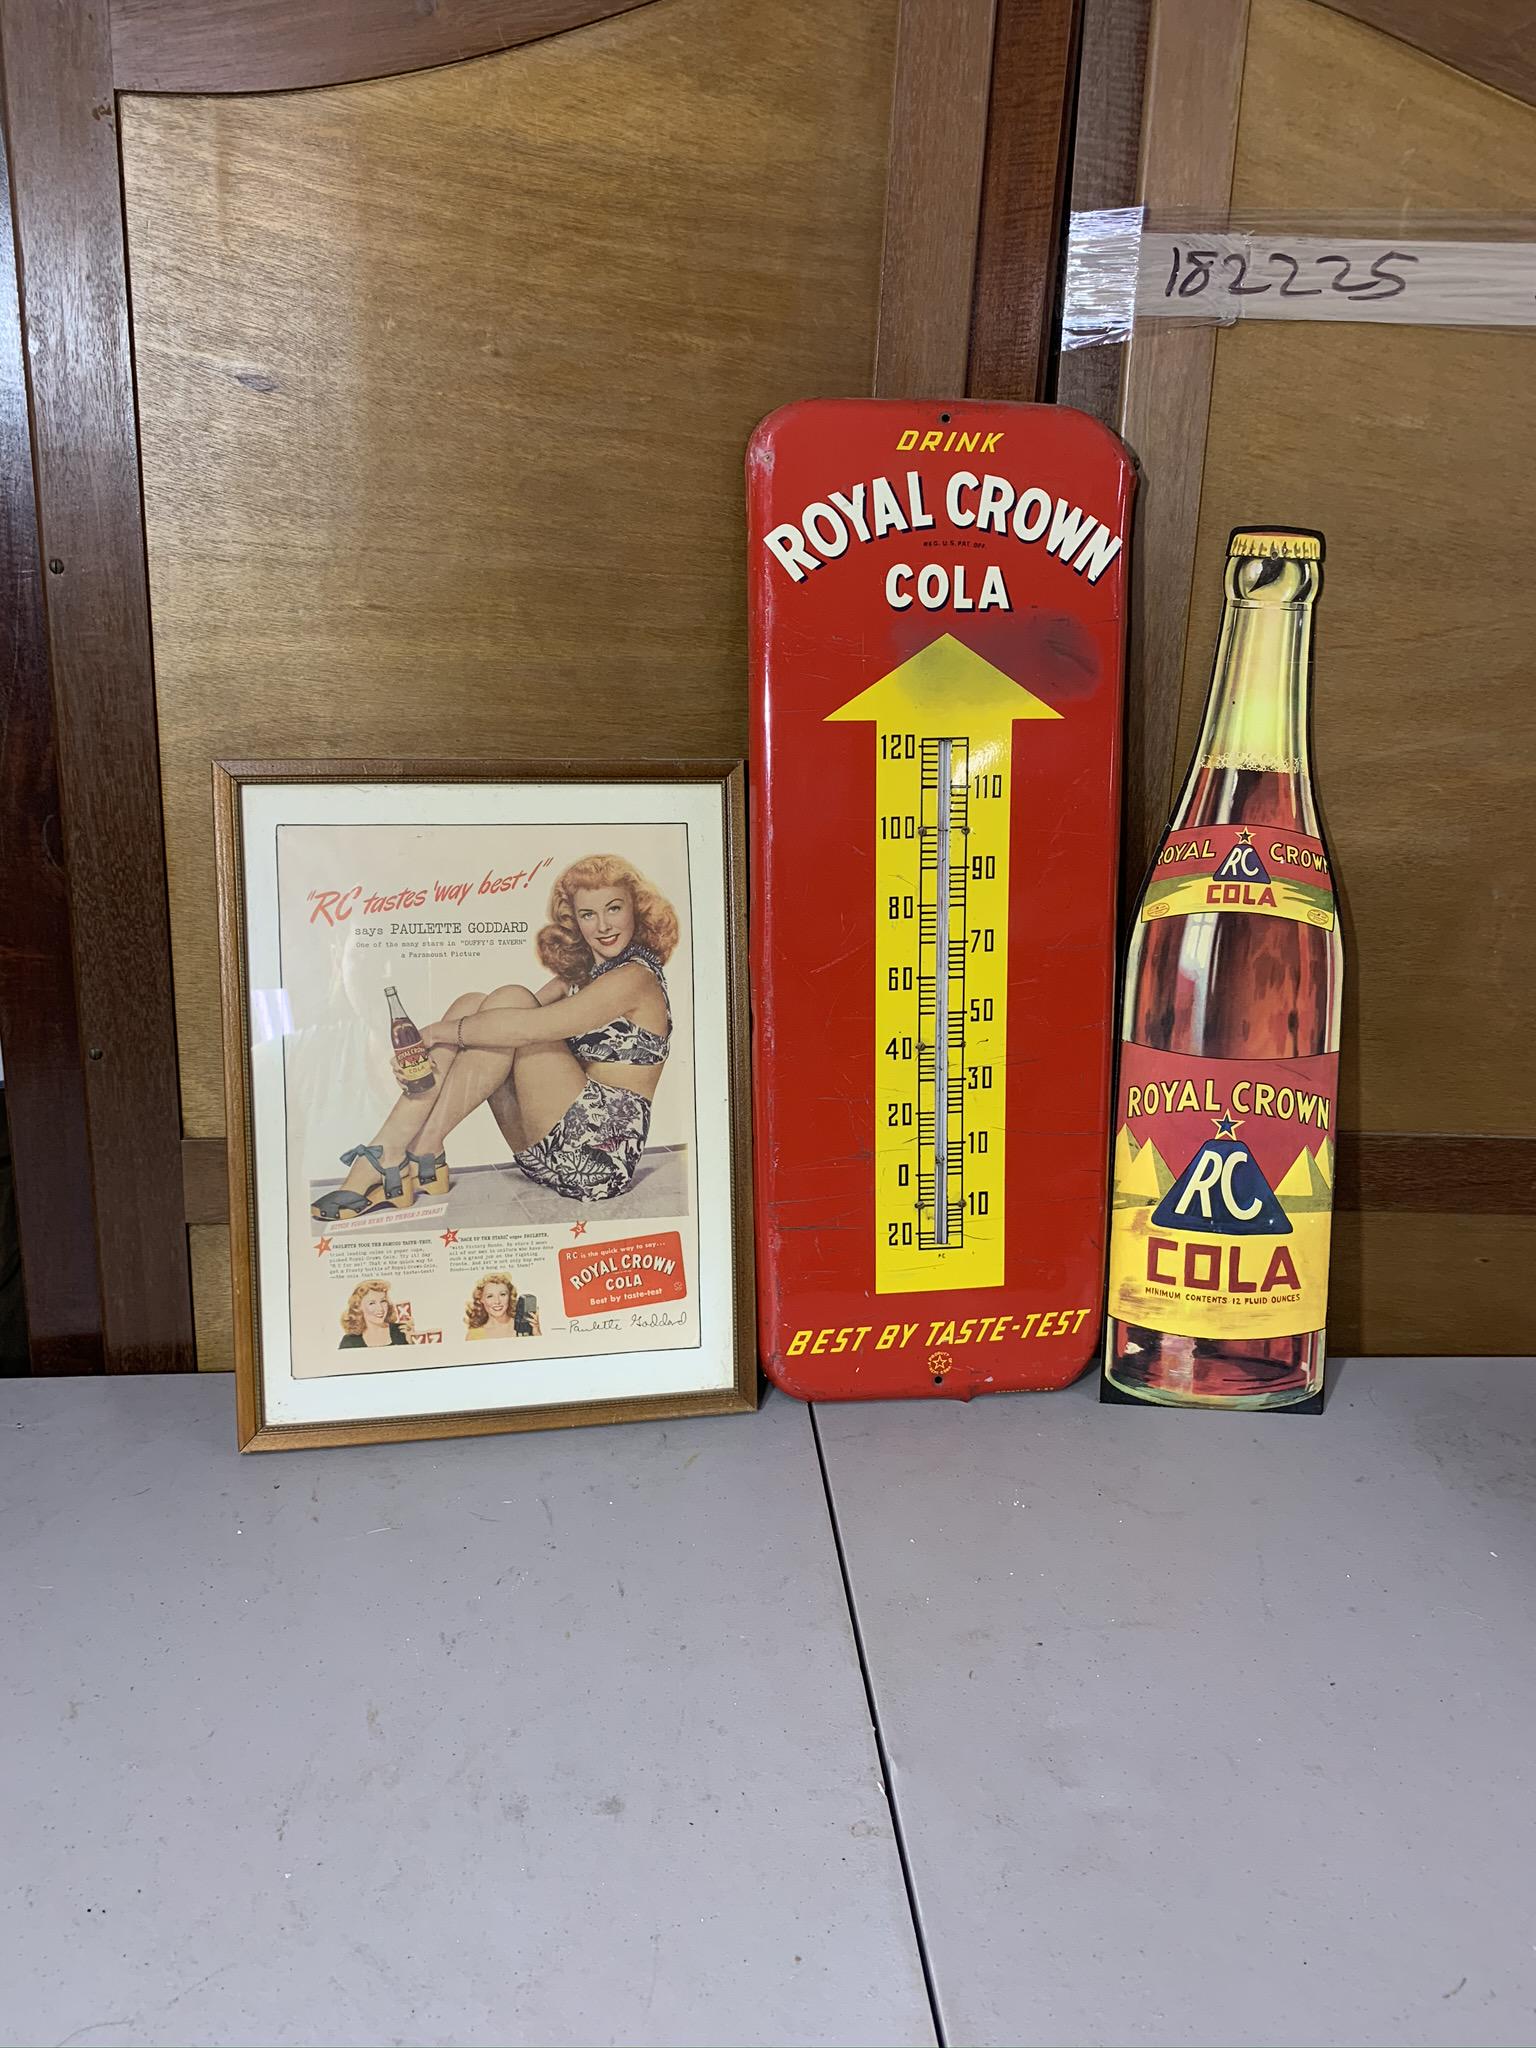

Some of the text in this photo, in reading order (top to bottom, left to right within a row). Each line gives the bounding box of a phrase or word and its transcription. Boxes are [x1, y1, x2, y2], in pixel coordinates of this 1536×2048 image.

[1166, 247, 1419, 300] 182225
[896, 430, 1005, 453] DRINK
[763, 471, 1123, 585] ROYAL CROWN
[885, 563, 1013, 612] COLA
[881, 734, 915, 759] 120
[974, 775, 1001, 798] 110
[881, 816, 914, 839] 100
[972, 856, 995, 880] 90
[1221, 847, 1259, 876] RC
[307, 857, 554, 927] "RC tastes 'way best!"
[1206, 884, 1277, 907] COLA
[889, 896, 913, 919] 80
[355, 922, 528, 937] says PAULETTE GODDARD
[971, 929, 994, 952] 70
[889, 967, 912, 990] 60
[970, 998, 993, 1022] 50
[886, 1038, 912, 1060] 40
[968, 1066, 992, 1089] 30
[888, 1103, 912, 1126] 20
[1127, 1078, 1331, 1131] ROYAL CROWN
[968, 1132, 988, 1154] 10
[898, 1164, 908, 1186] 0
[1174, 1150, 1263, 1221] RC
[968, 1192, 988, 1216] 10
[888, 1222, 912, 1246] 20
[600, 1248, 618, 1256] quick
[620, 1245, 634, 1253] way
[570, 1254, 676, 1290] ROYAL CROWN
[1147, 1236, 1302, 1293] COLA
[605, 1274, 642, 1291] COLA
[590, 1288, 662, 1306] Best by taste-test
[1145, 1286, 1181, 1300] MINIMUM
[1185, 1294, 1228, 1304] CONTENTS
[1244, 1296, 1268, 1304] FLUID
[1271, 1294, 1300, 1304] OUNCES
[630, 1311, 687, 1328] Goddard
[786, 1308, 1091, 1356] BEST BY TASTE-TEST
